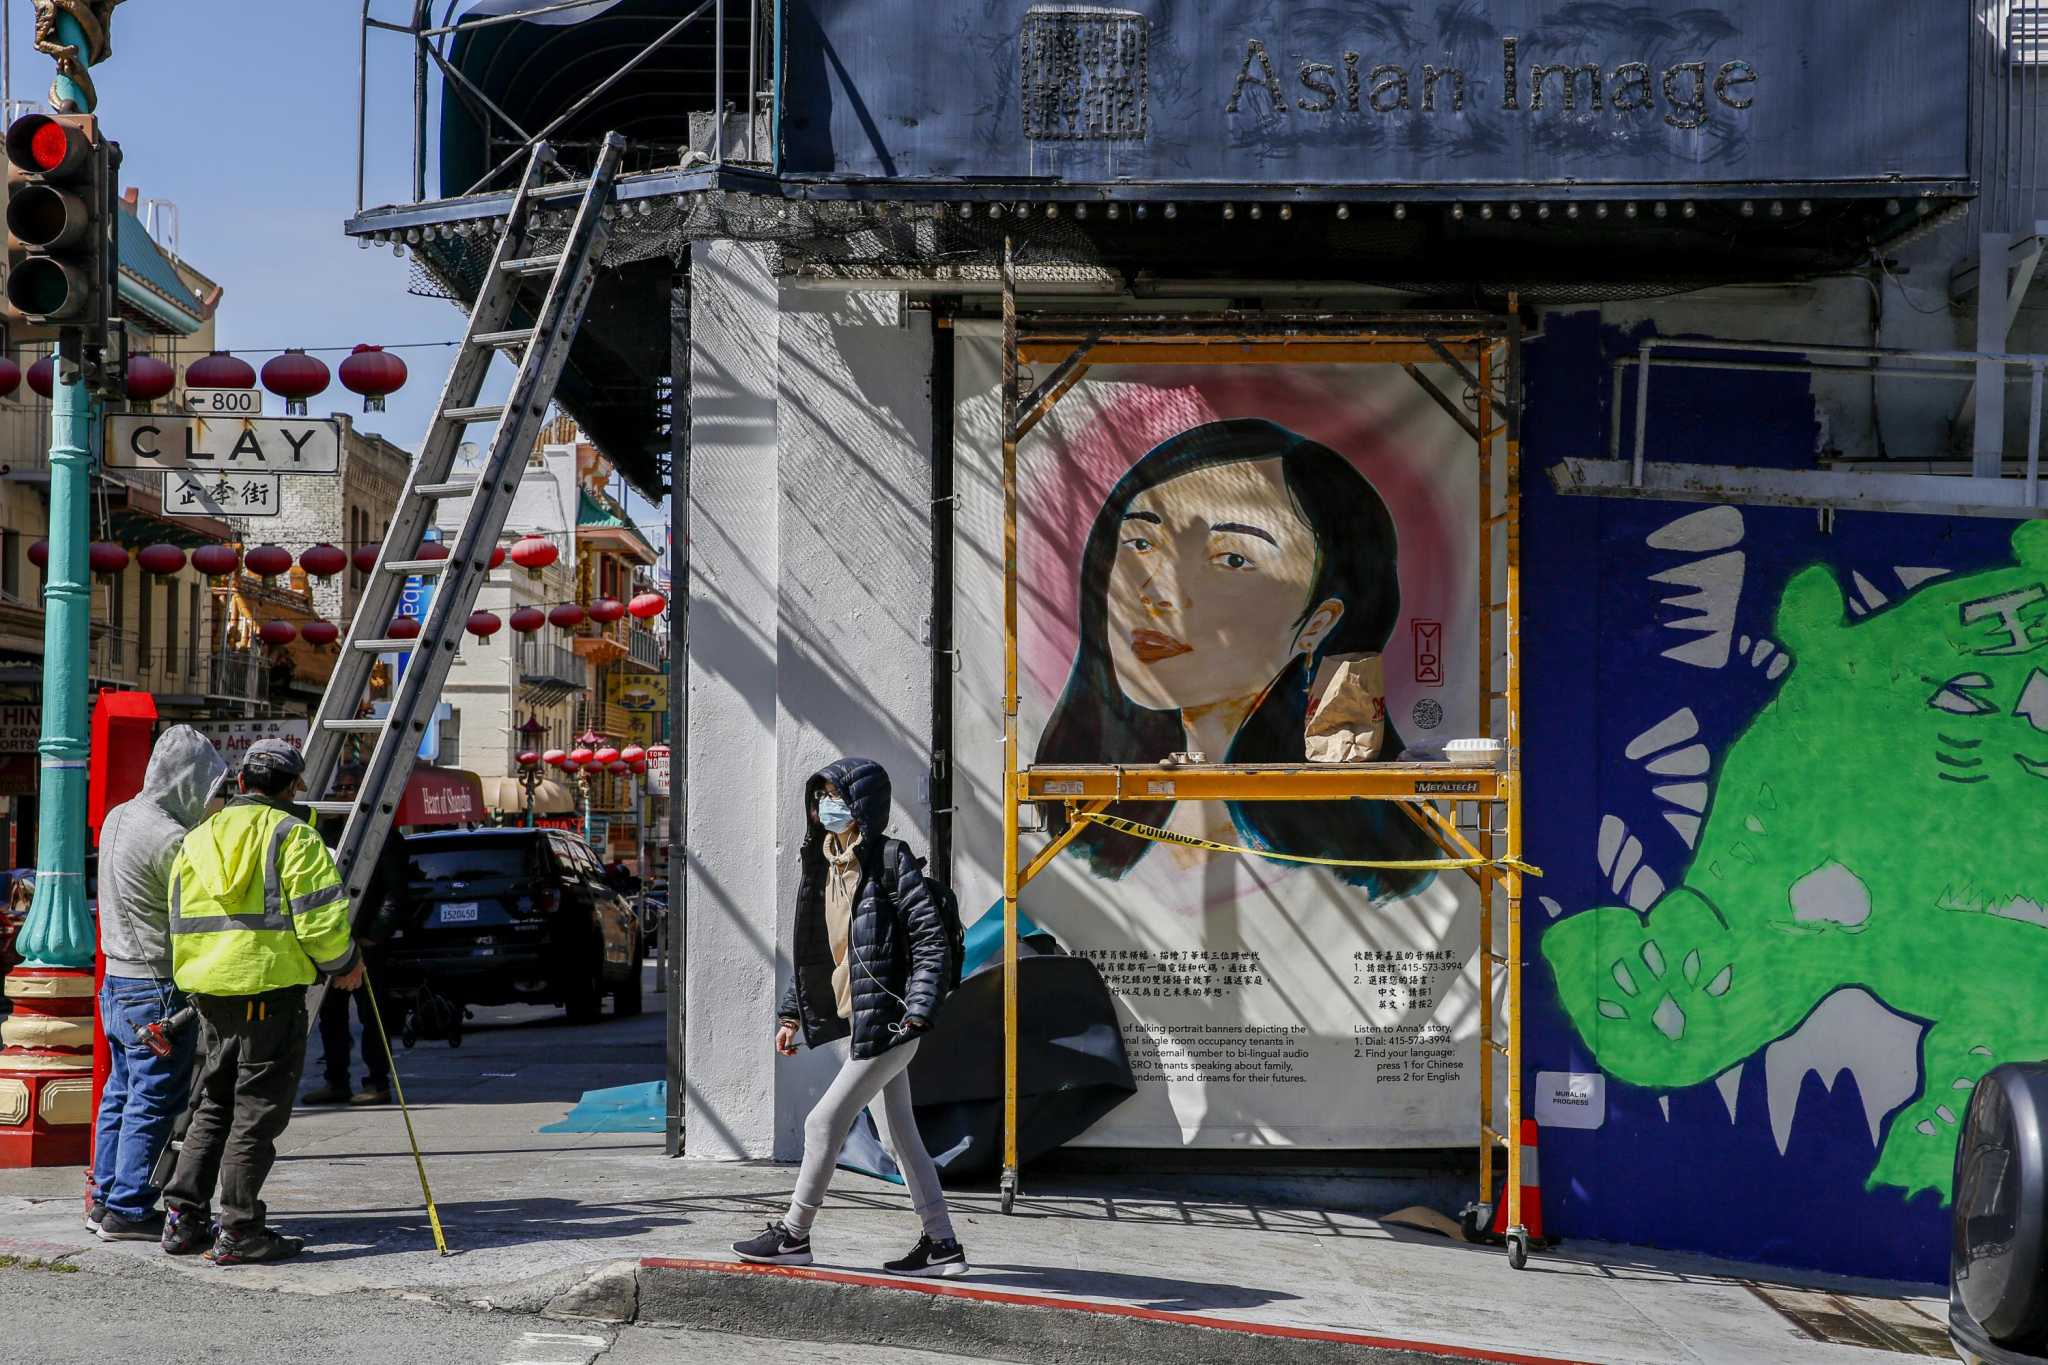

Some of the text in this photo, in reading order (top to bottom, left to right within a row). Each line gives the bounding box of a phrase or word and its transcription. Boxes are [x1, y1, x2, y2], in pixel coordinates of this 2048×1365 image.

[1225, 37, 1465, 113] Asian
[1501, 36, 1759, 128] Image
[212, 393, 251, 411] 800
[130, 425, 316, 462] CLAY
[1418, 626, 1438, 678] VIDA
[1354, 963, 1362, 973] 1.
[1353, 975, 1362, 985] 2.
[1123, 1025, 1306, 1035] of talking portrait banners depicting the
[1354, 1025, 1381, 1034] Listen
[1384, 1026, 1394, 1034] to
[1141, 1037, 1169, 1047] single
[1198, 1038, 1247, 1048] occupancy
[1249, 1038, 1284, 1046] tenants
[1286, 1037, 1294, 1046] in
[1354, 1035, 1451, 1046] 1. Dial: 415-573-3994
[1141, 1049, 1185, 1057] voicemail
[1187, 1049, 1224, 1057] number
[1238, 1049, 1281, 1059] bi-lingual
[1283, 1049, 1309, 1058] audio
[1353, 1048, 1456, 1060] 2. Find your language:
[1131, 1061, 1293, 1072] SRO tenants speaking about family,
[1376, 1059, 1464, 1072] press 1 for Chinese
[1176, 1073, 1194, 1082] and
[1196, 1073, 1231, 1082] dreams
[1232, 1073, 1247, 1082] for
[1248, 1073, 1270, 1082] their
[1271, 1073, 1307, 1083] futures.
[1376, 1072, 1460, 1084] press 2 for English
[1555, 1090, 1579, 1098] MURAL
[1552, 1098, 1589, 1106] PROGRESS
